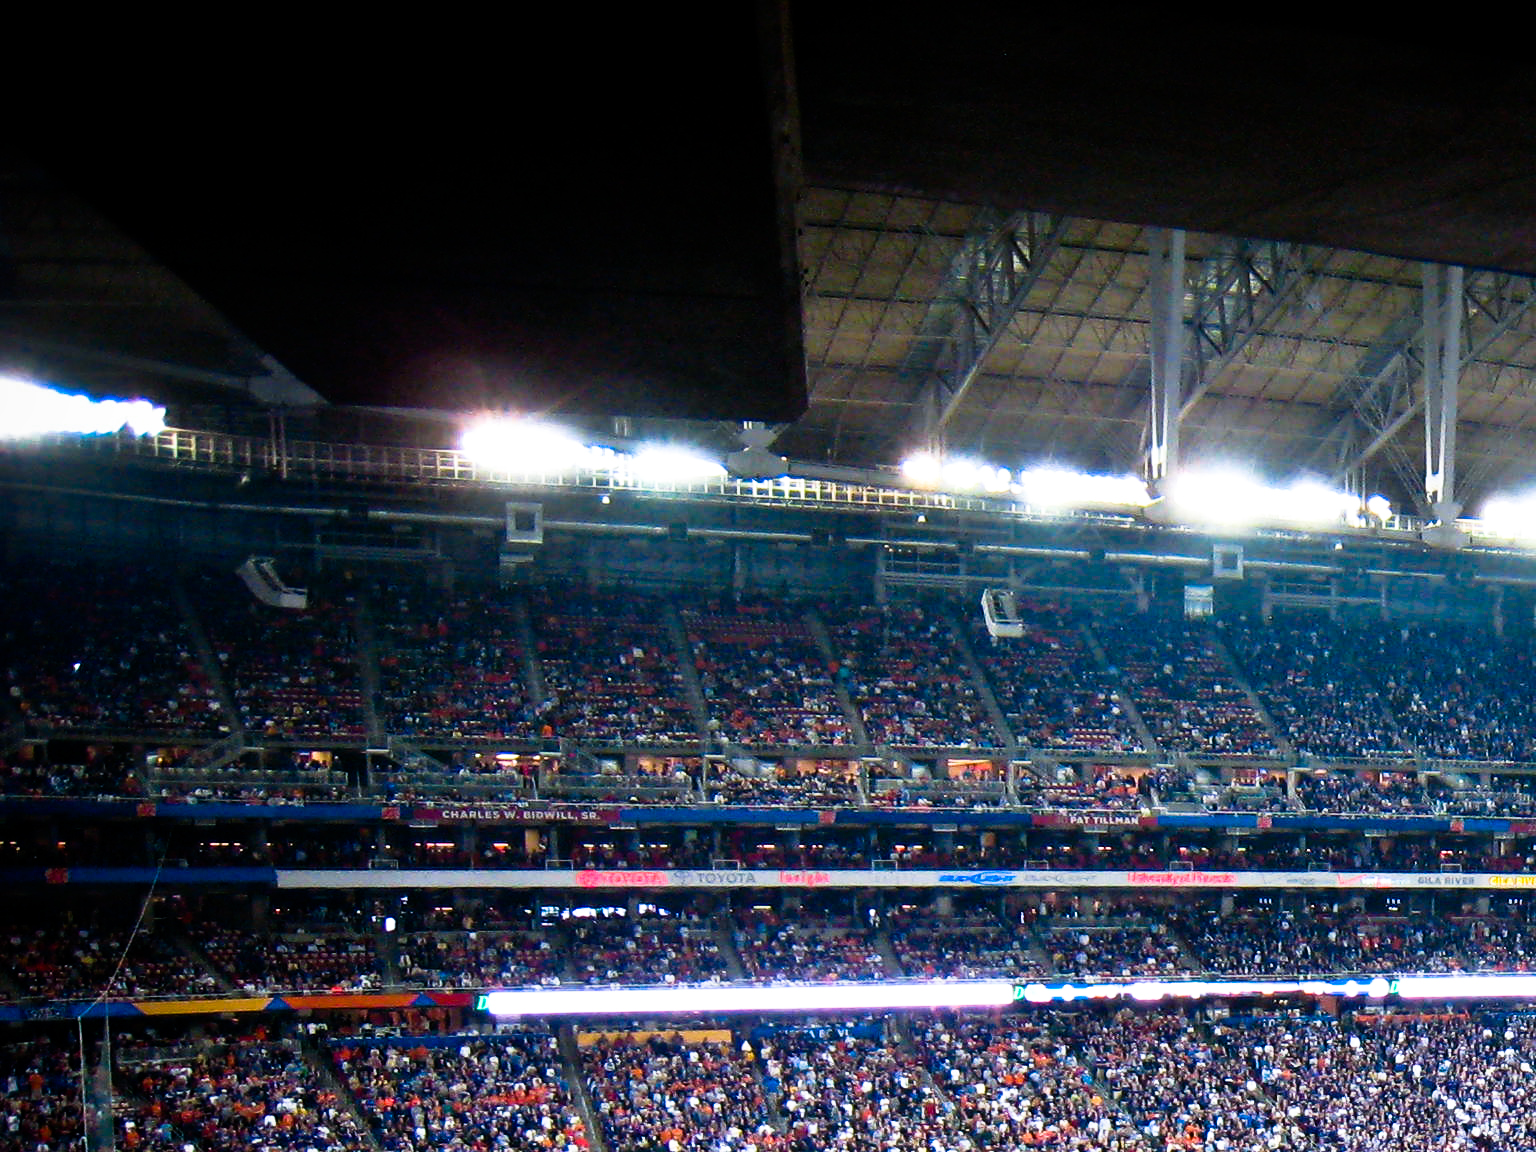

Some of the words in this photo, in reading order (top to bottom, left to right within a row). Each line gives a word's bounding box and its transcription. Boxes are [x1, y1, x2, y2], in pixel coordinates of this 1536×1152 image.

[442, 809, 500, 819] CHARLES
[504, 810, 519, 819] W.
[523, 810, 578, 820] BIDWILL,
[582, 811, 600, 820] SR.
[1070, 816, 1091, 824] PAT
[1093, 816, 1139, 825] TILLMAN
[698, 872, 756, 884] TOYOTA
[1418, 876, 1443, 885] GILA
[1444, 876, 1475, 886] RIVER
[1489, 876, 1515, 886] GILA
